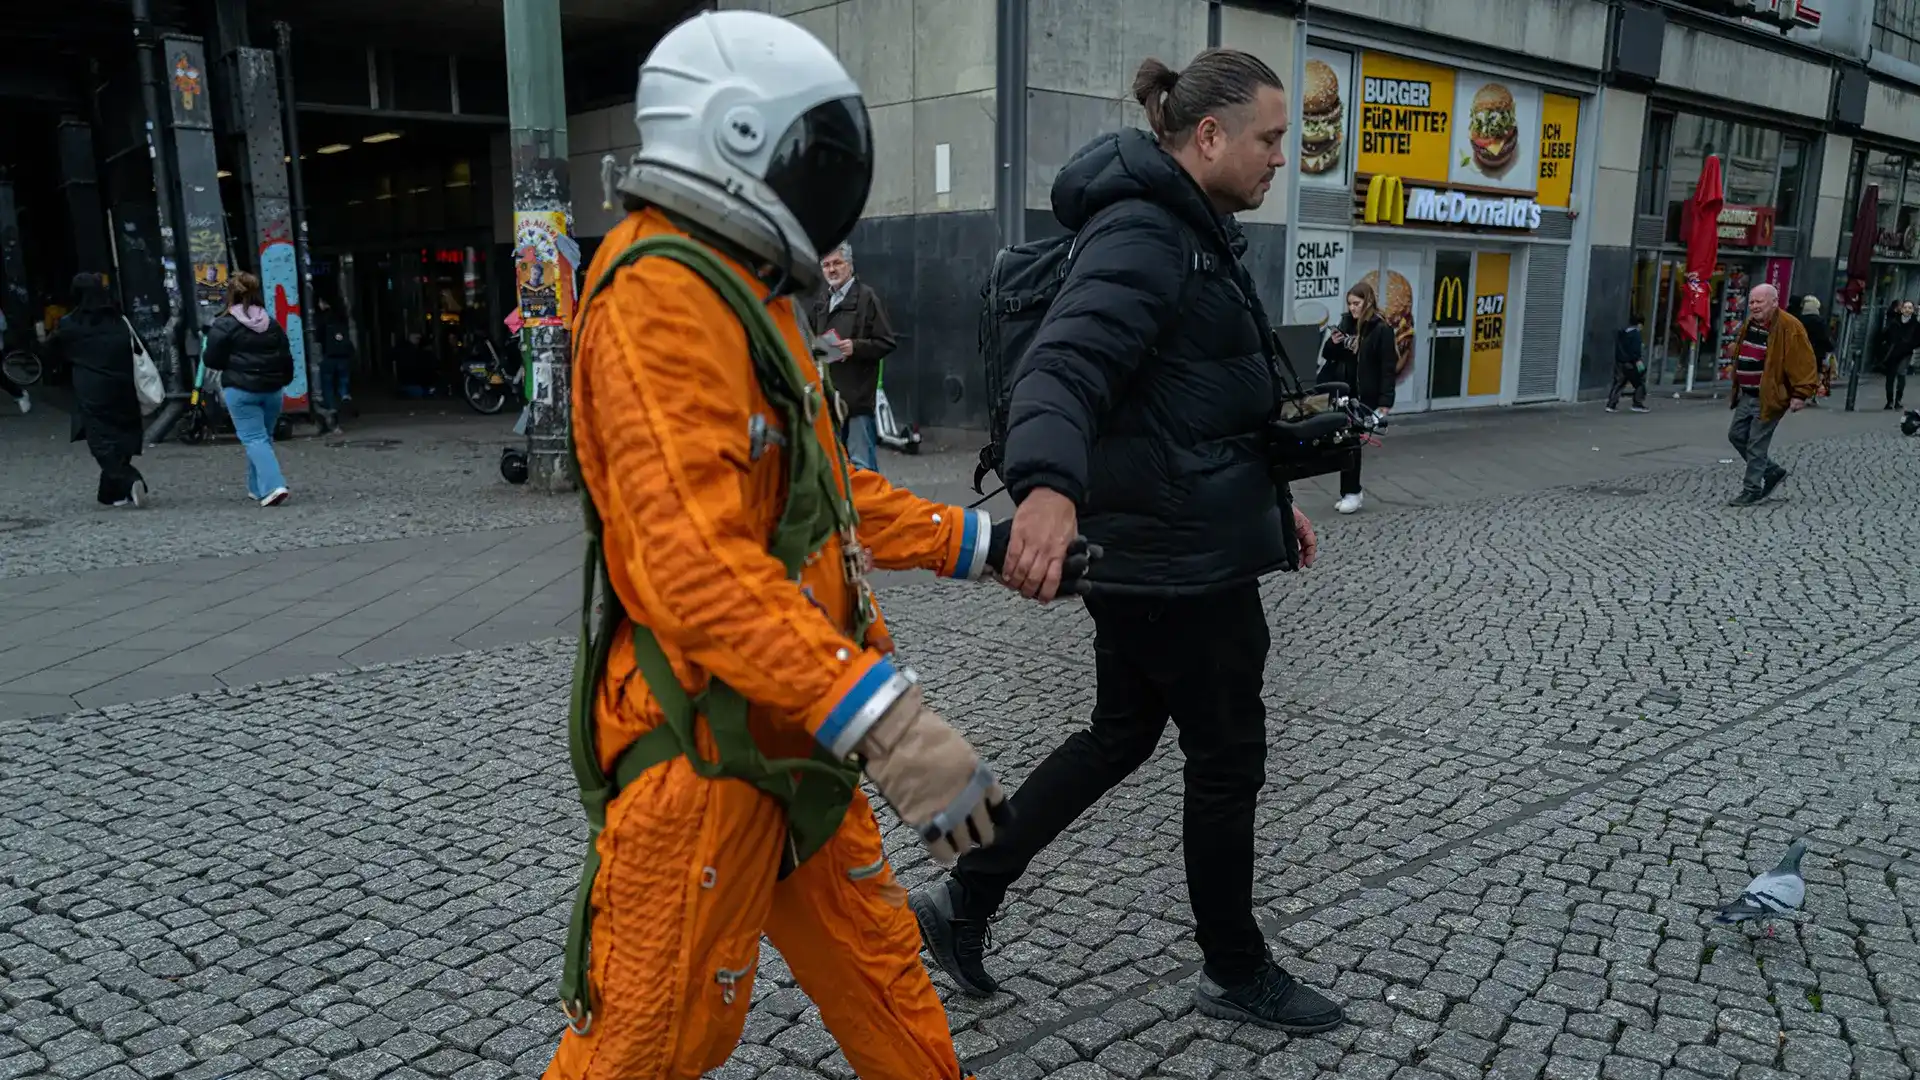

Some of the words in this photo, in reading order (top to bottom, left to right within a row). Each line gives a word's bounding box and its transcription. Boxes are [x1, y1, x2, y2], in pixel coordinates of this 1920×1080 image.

[1364, 78, 1430, 106] BURGER
[1395, 108, 1448, 133] MITTE?
[1543, 123, 1561, 140] ICH
[1362, 131, 1411, 154] BITTE!
[1542, 142, 1572, 159] LIEBE
[1540, 161, 1558, 178] ES!
[1411, 188, 1541, 229] McDonald's
[1297, 241, 1344, 259] CHLAF-
[1316, 261, 1329, 277] IN
[1477, 295, 1504, 315] 24/7
